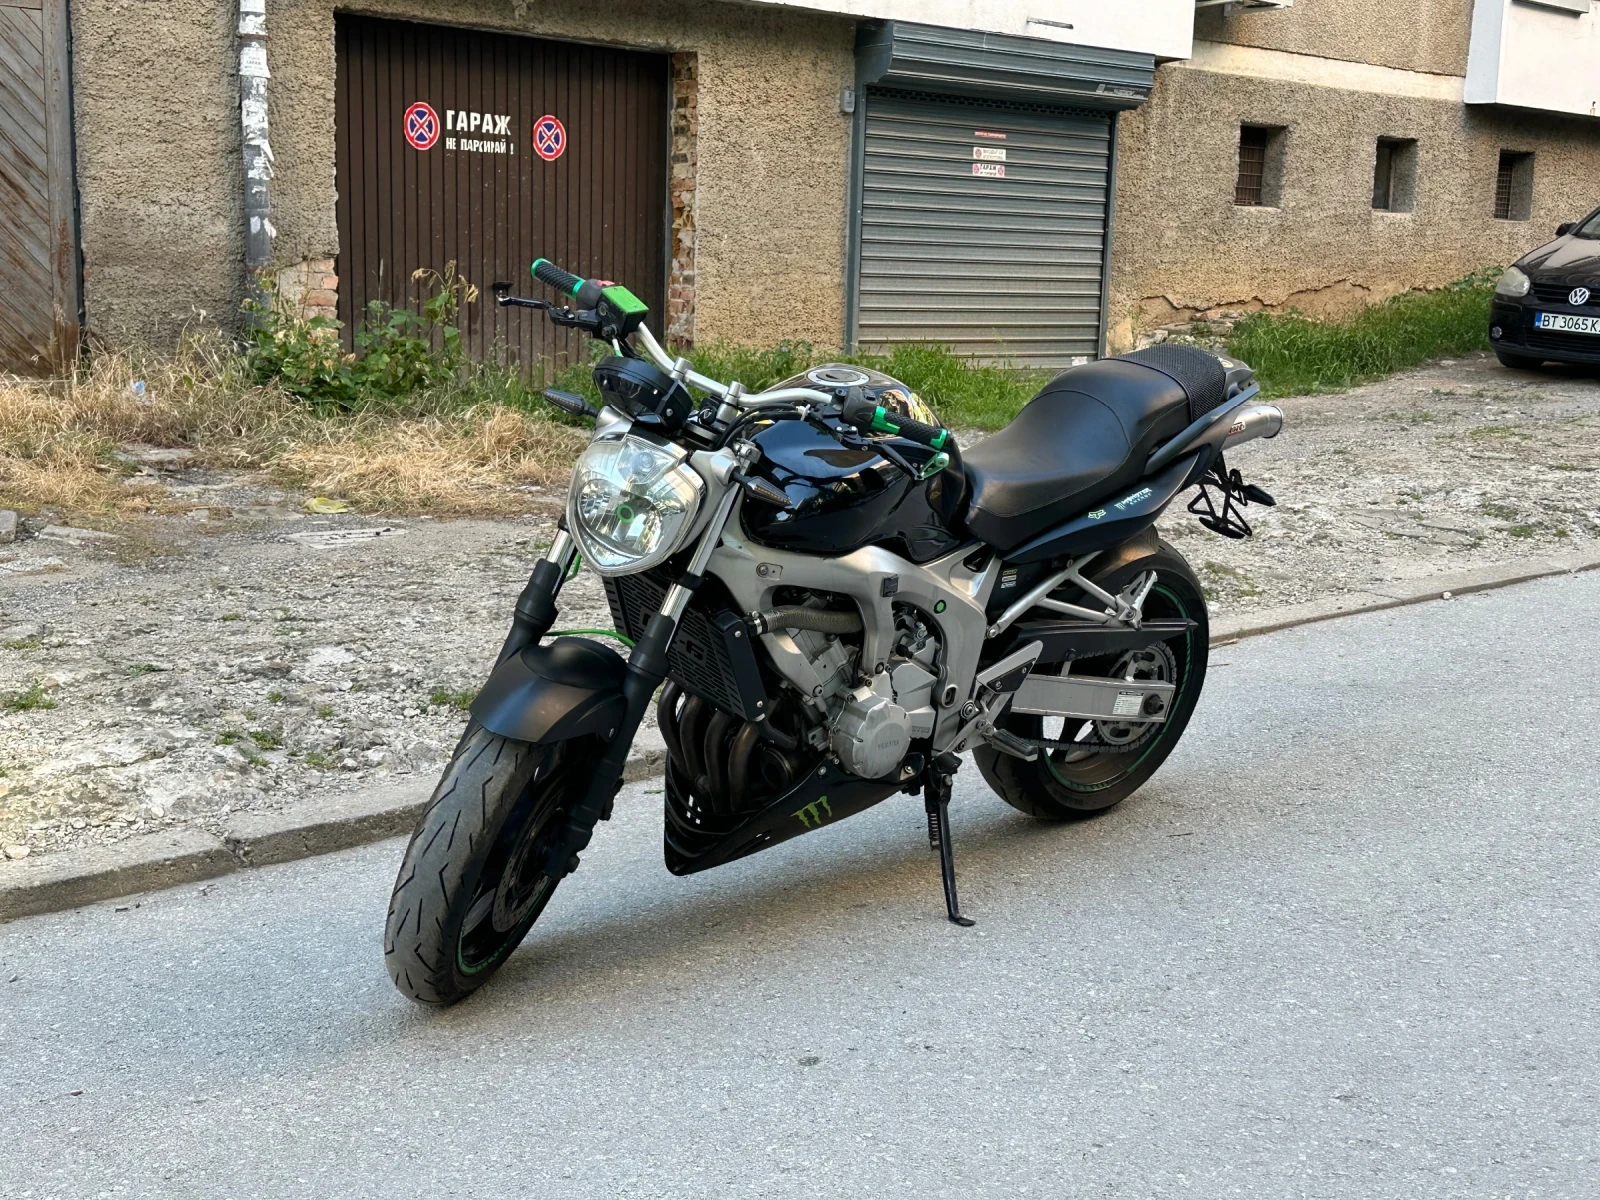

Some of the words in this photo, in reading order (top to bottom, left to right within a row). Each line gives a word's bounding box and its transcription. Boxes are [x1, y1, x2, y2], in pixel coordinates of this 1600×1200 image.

[446, 109, 511, 135] ГАРАЖ
[446, 137, 457, 150] НЕ
[1542, 315, 1559, 328] BT
[1559, 317, 1589, 331] 3065
[1590, 319, 1600, 332] K
